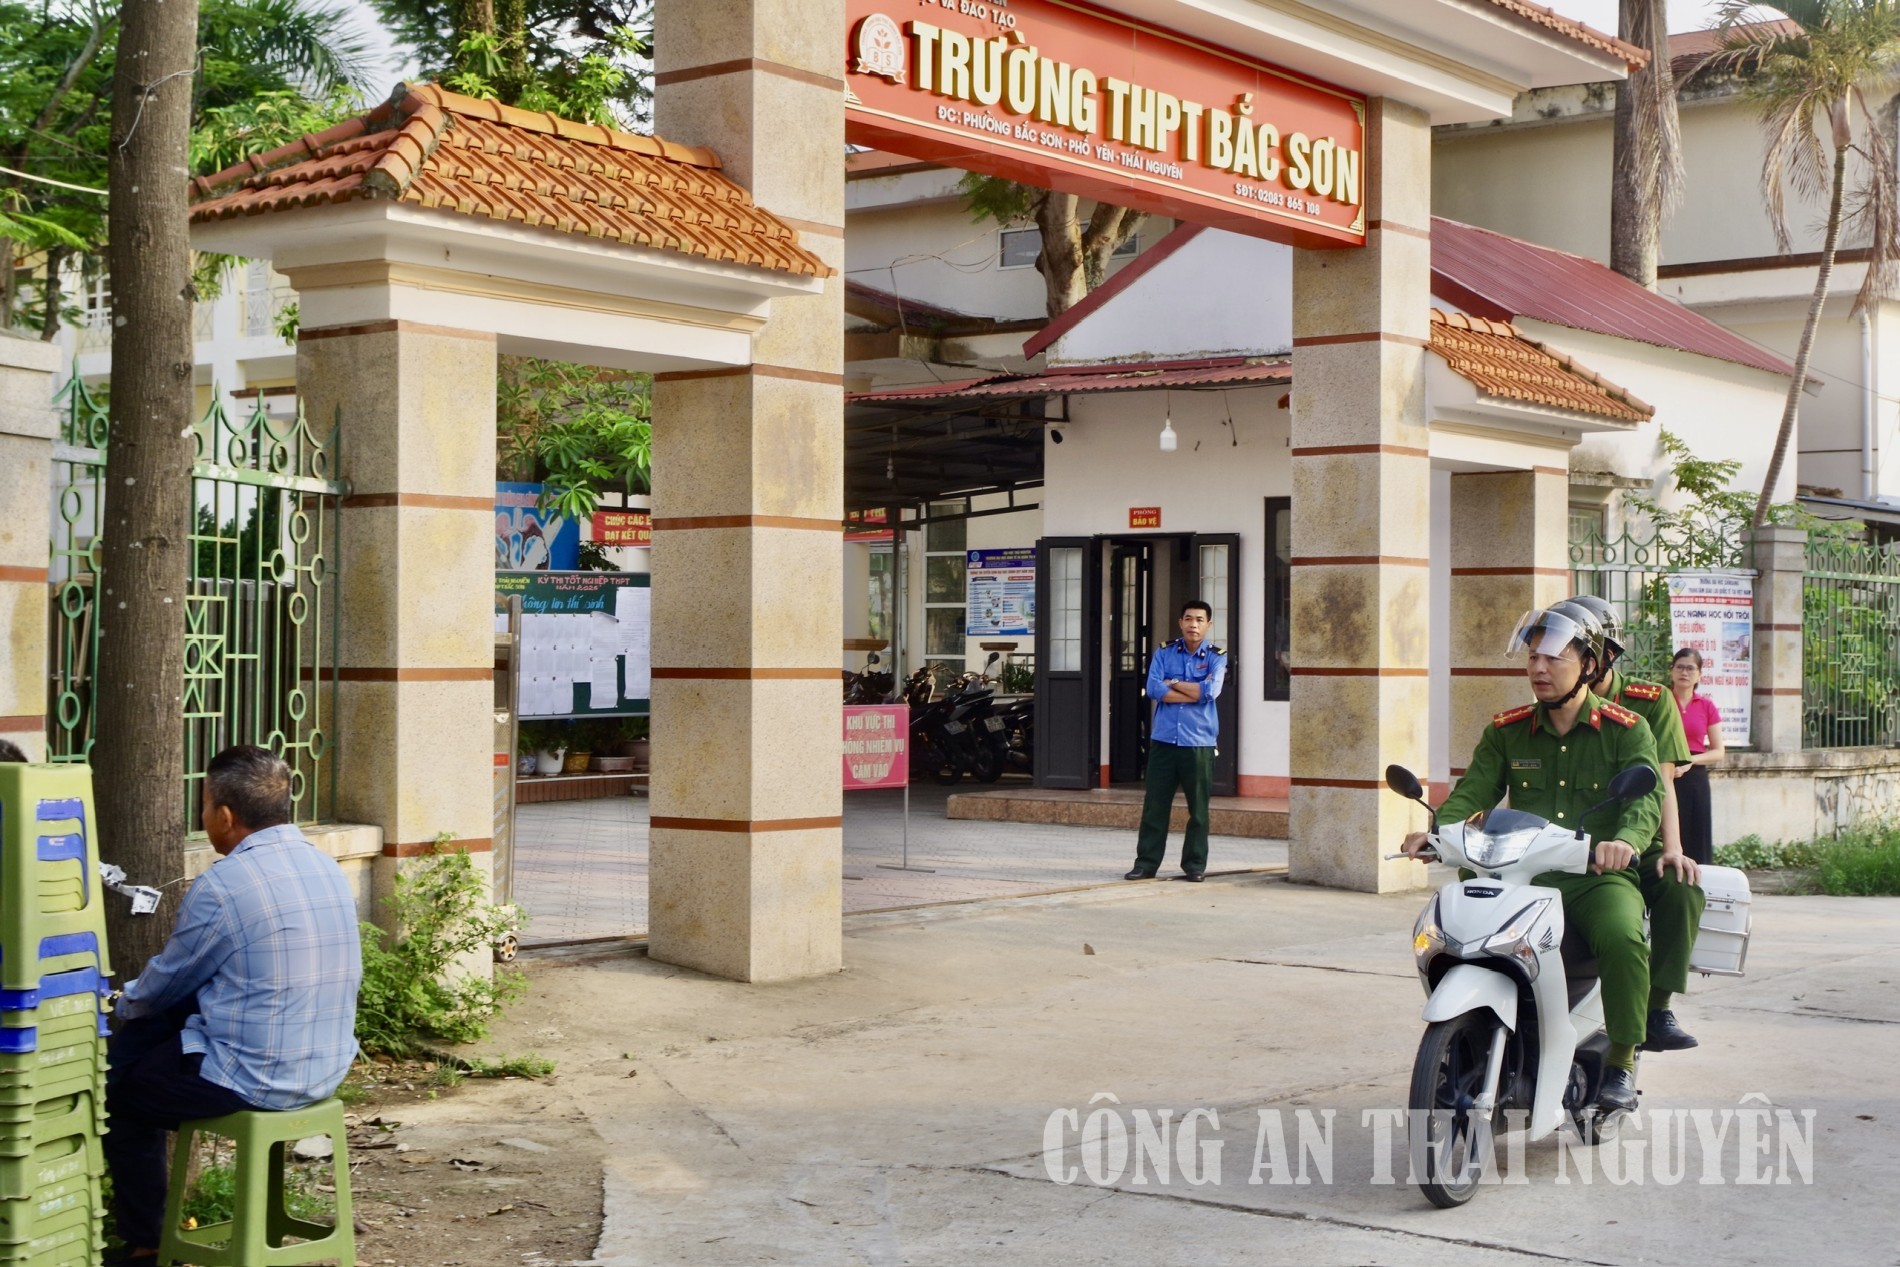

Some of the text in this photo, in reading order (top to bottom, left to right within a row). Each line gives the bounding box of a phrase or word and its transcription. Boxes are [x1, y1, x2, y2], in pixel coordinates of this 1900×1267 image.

[991, 9, 1017, 31] TẠO
[908, 20, 1097, 134] TRƯỜNG
[1104, 77, 1203, 162] THPT
[1207, 92, 1280, 182] BẮC
[1286, 132, 1359, 205] SƠN
[963, 111, 1011, 136] PHƯỜNG
[1014, 121, 1037, 142] BẮC
[1145, 160, 1183, 180] NGUYÊN
[1287, 195, 1303, 212] 865
[1306, 200, 1321, 216] 108
[605, 514, 652, 526] CHÚC CÁC E
[1132, 516, 1157, 527] BẢO VỆ
[621, 528, 636, 540] KẾT
[610, 577, 630, 585] THPT
[522, 594, 548, 614] hông
[847, 715, 863, 730] KHU
[882, 714, 895, 729] THI
[843, 737, 865, 755] HÔNG
[866, 736, 892, 756] NHIỆM
